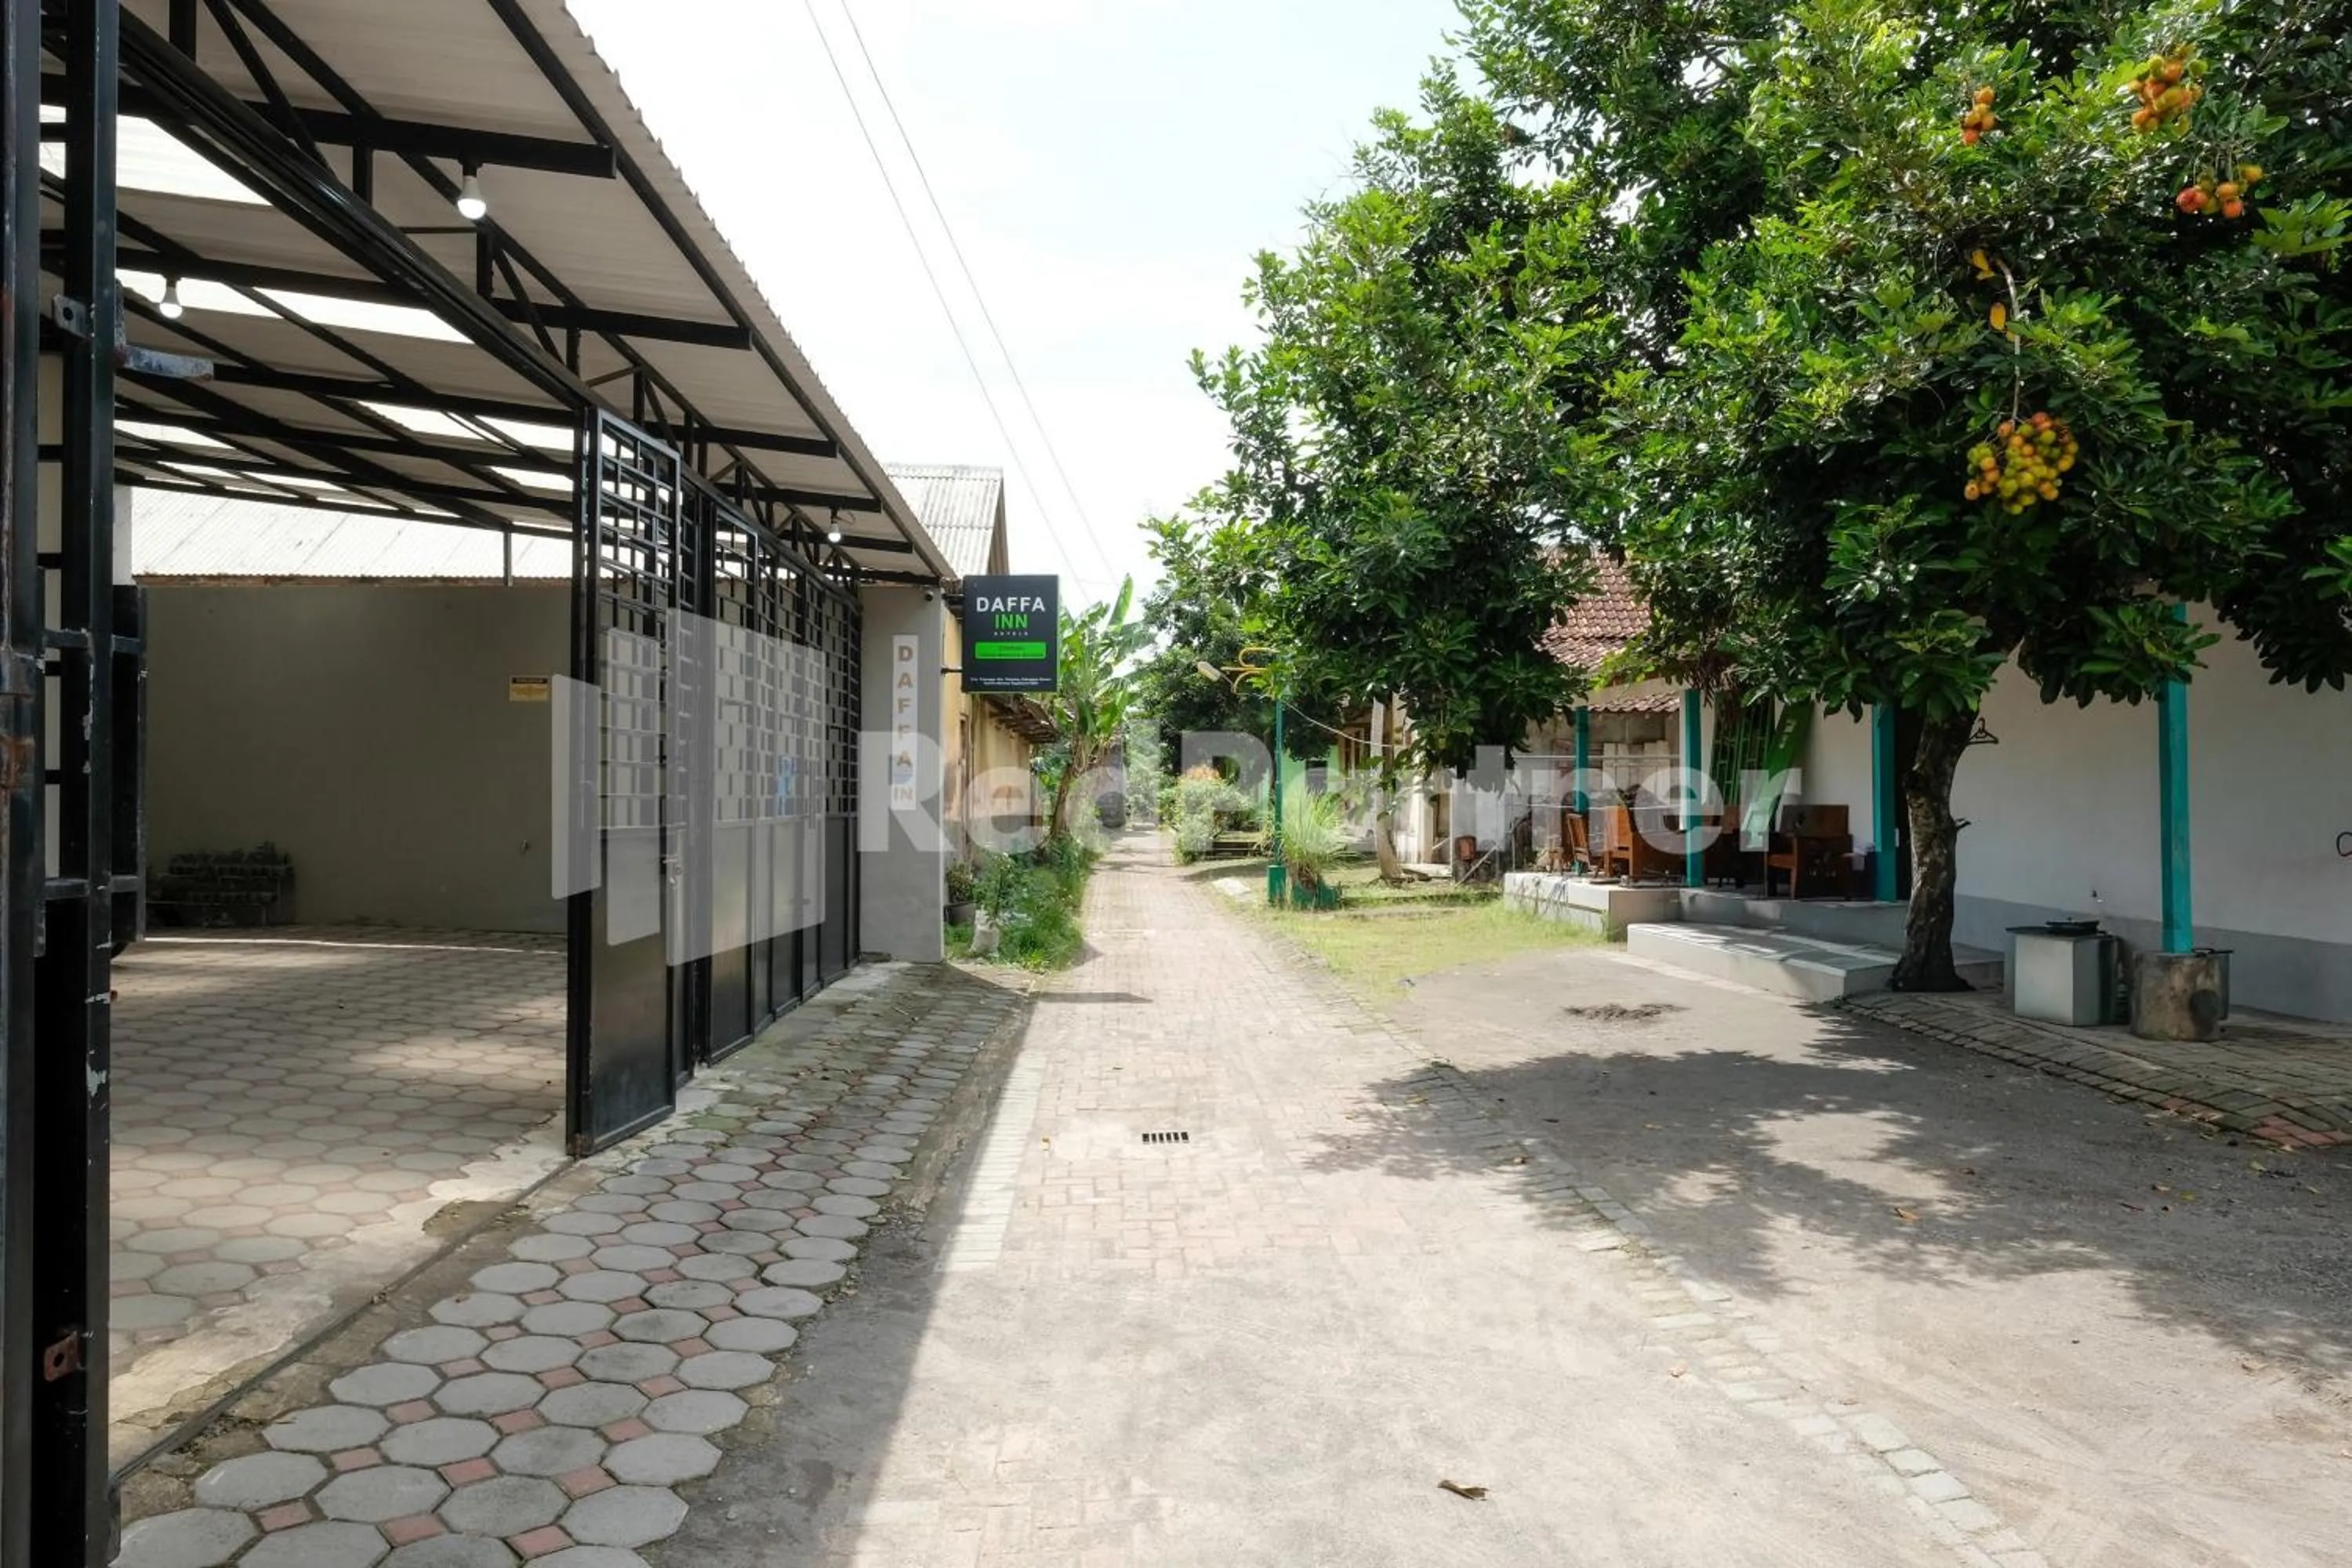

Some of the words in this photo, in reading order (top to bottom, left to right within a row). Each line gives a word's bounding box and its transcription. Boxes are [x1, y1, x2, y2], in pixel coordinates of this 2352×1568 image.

[976, 597, 1045, 612] DAFFA
[995, 614, 1028, 628] INN
[897, 645, 913, 766] DAFFA
